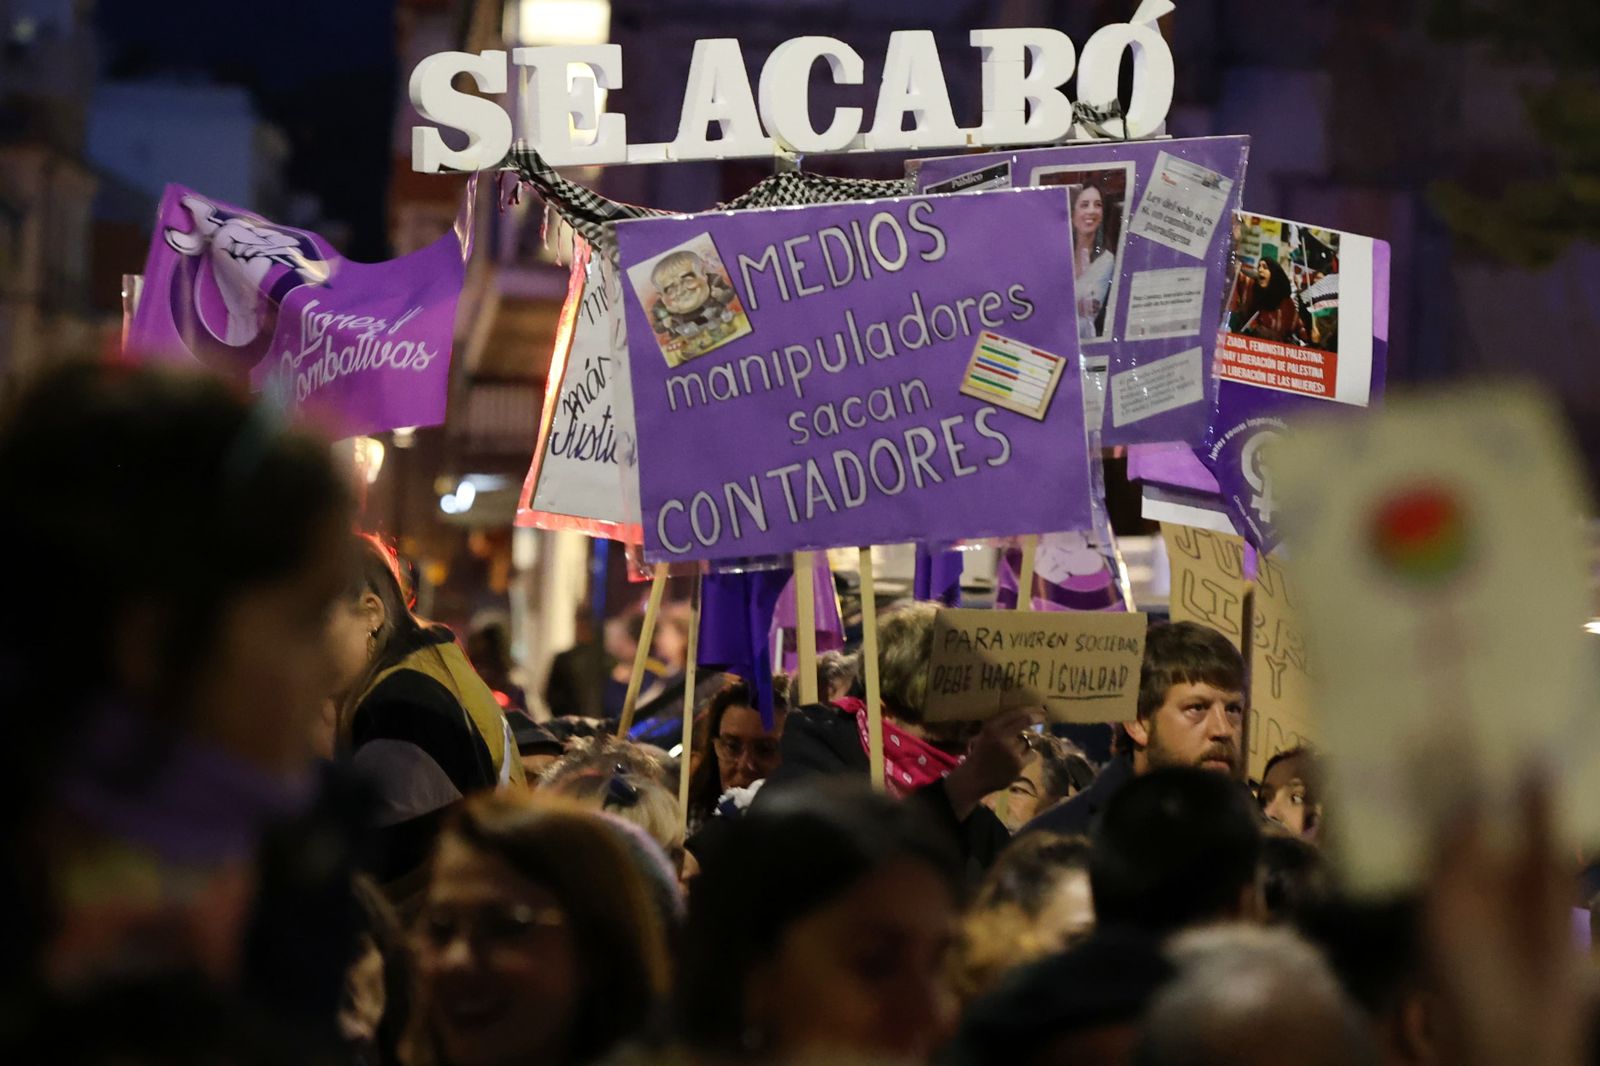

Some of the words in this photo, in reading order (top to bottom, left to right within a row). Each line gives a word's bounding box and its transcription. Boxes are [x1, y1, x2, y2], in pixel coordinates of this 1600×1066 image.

[409, 44, 627, 173] SE
[675, 0, 1176, 154] ACABÓ
[736, 199, 948, 311] MEDIOS
[665, 283, 1035, 411] manipuladores
[1237, 352, 1277, 369] LIBERACIÓN
[1277, 360, 1286, 372] DE
[1287, 361, 1324, 379] PALESTINA
[1249, 340, 1285, 356] FEMINISTA
[1227, 364, 1267, 383] LIBERACIÓN
[1267, 372, 1277, 385] DE
[1277, 374, 1291, 386] LAS
[788, 378, 933, 446] sacan
[656, 405, 1012, 556] CONTADORES
[944, 626, 1003, 651] PARA
[932, 663, 972, 695] DEBE
[980, 658, 1040, 692] HABER
[1048, 659, 1129, 694] IGUALDAD
